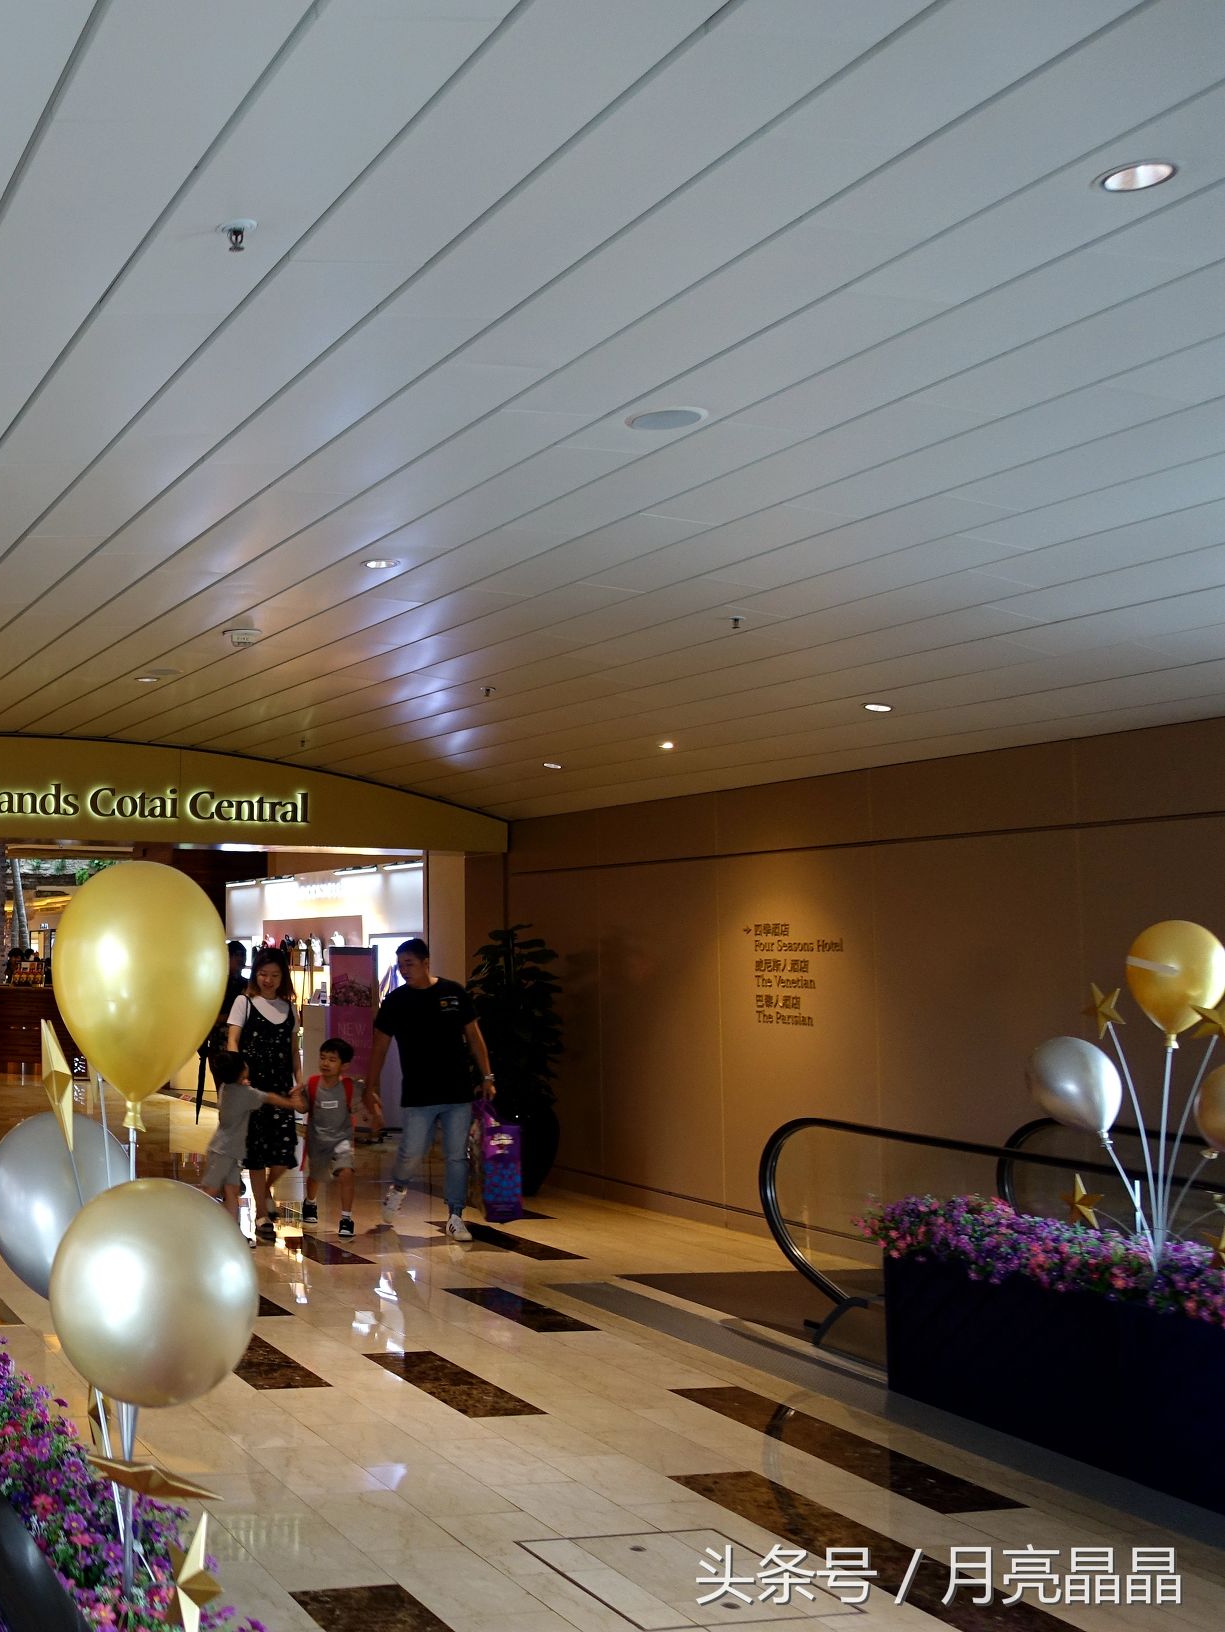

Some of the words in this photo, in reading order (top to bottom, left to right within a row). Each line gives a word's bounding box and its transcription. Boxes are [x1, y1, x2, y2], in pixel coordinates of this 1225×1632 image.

[90, 786, 178, 819] Cotai
[190, 790, 311, 824] Central
[754, 939, 775, 952] Four
[777, 939, 814, 952] Seasons
[817, 938, 843, 952] Hotel
[754, 974, 773, 988] The
[774, 976, 816, 989] Venetian
[756, 1010, 774, 1023] The
[776, 1011, 814, 1027] Parisian
[337, 1022, 367, 1036] NEW
